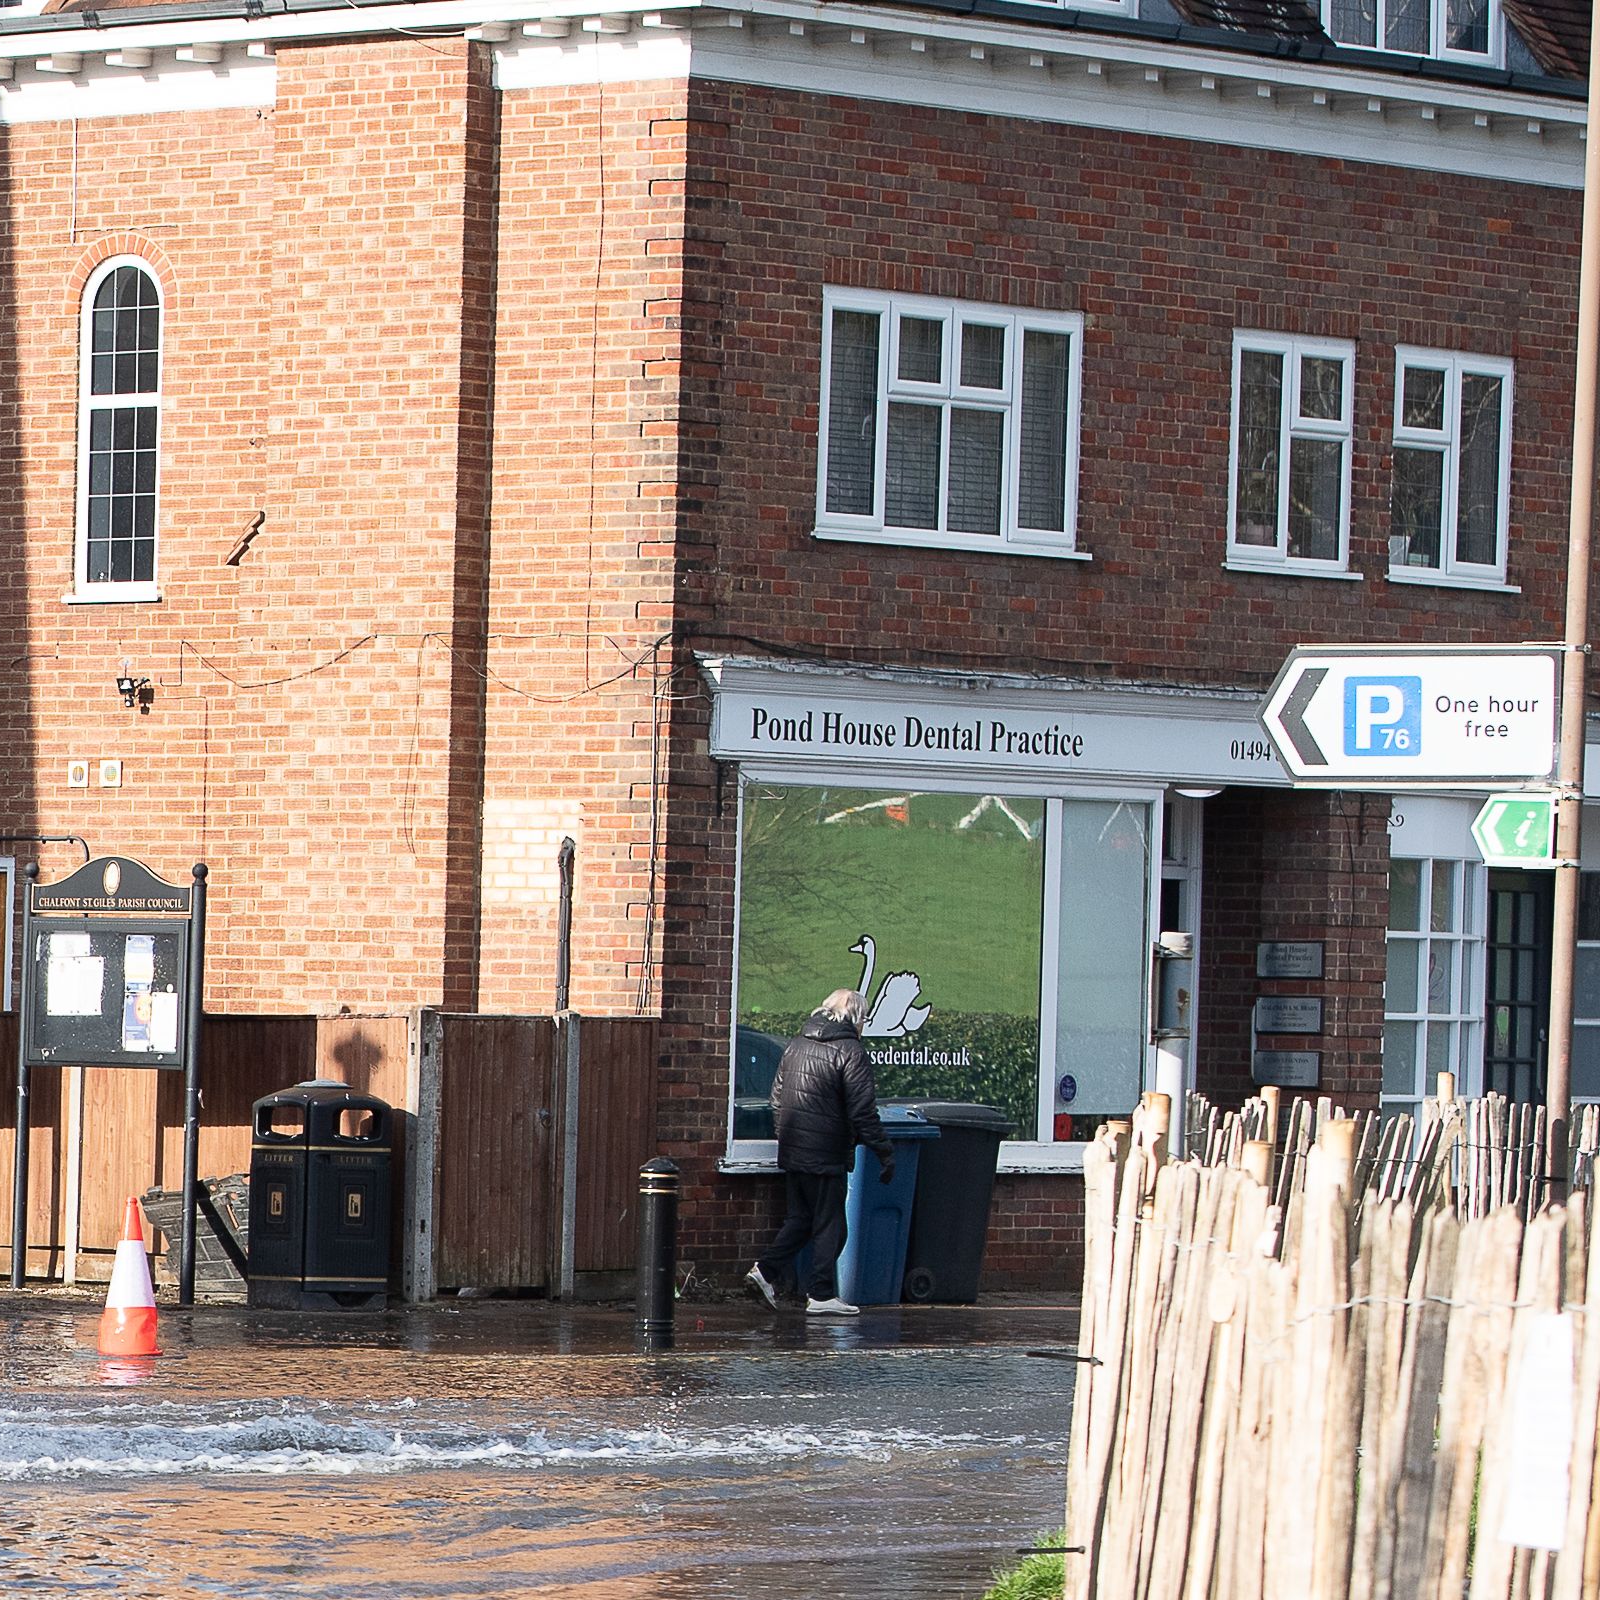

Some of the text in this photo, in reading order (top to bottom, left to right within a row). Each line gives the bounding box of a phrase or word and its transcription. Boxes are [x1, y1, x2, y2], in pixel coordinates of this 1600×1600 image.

[1435, 694, 1540, 714] One hour
[751, 707, 1085, 758] Pond House Dental Practice
[1379, 728, 1410, 749] 76
[1464, 719, 1509, 738] free
[1231, 739, 1271, 761] 01494
[39, 897, 81, 907] CHALFONT
[118, 898, 145, 908] PARISH
[148, 898, 183, 909] COUNCIL
[867, 1046, 971, 1066] sedental.co.uk
[264, 1154, 294, 1162] LITTER
